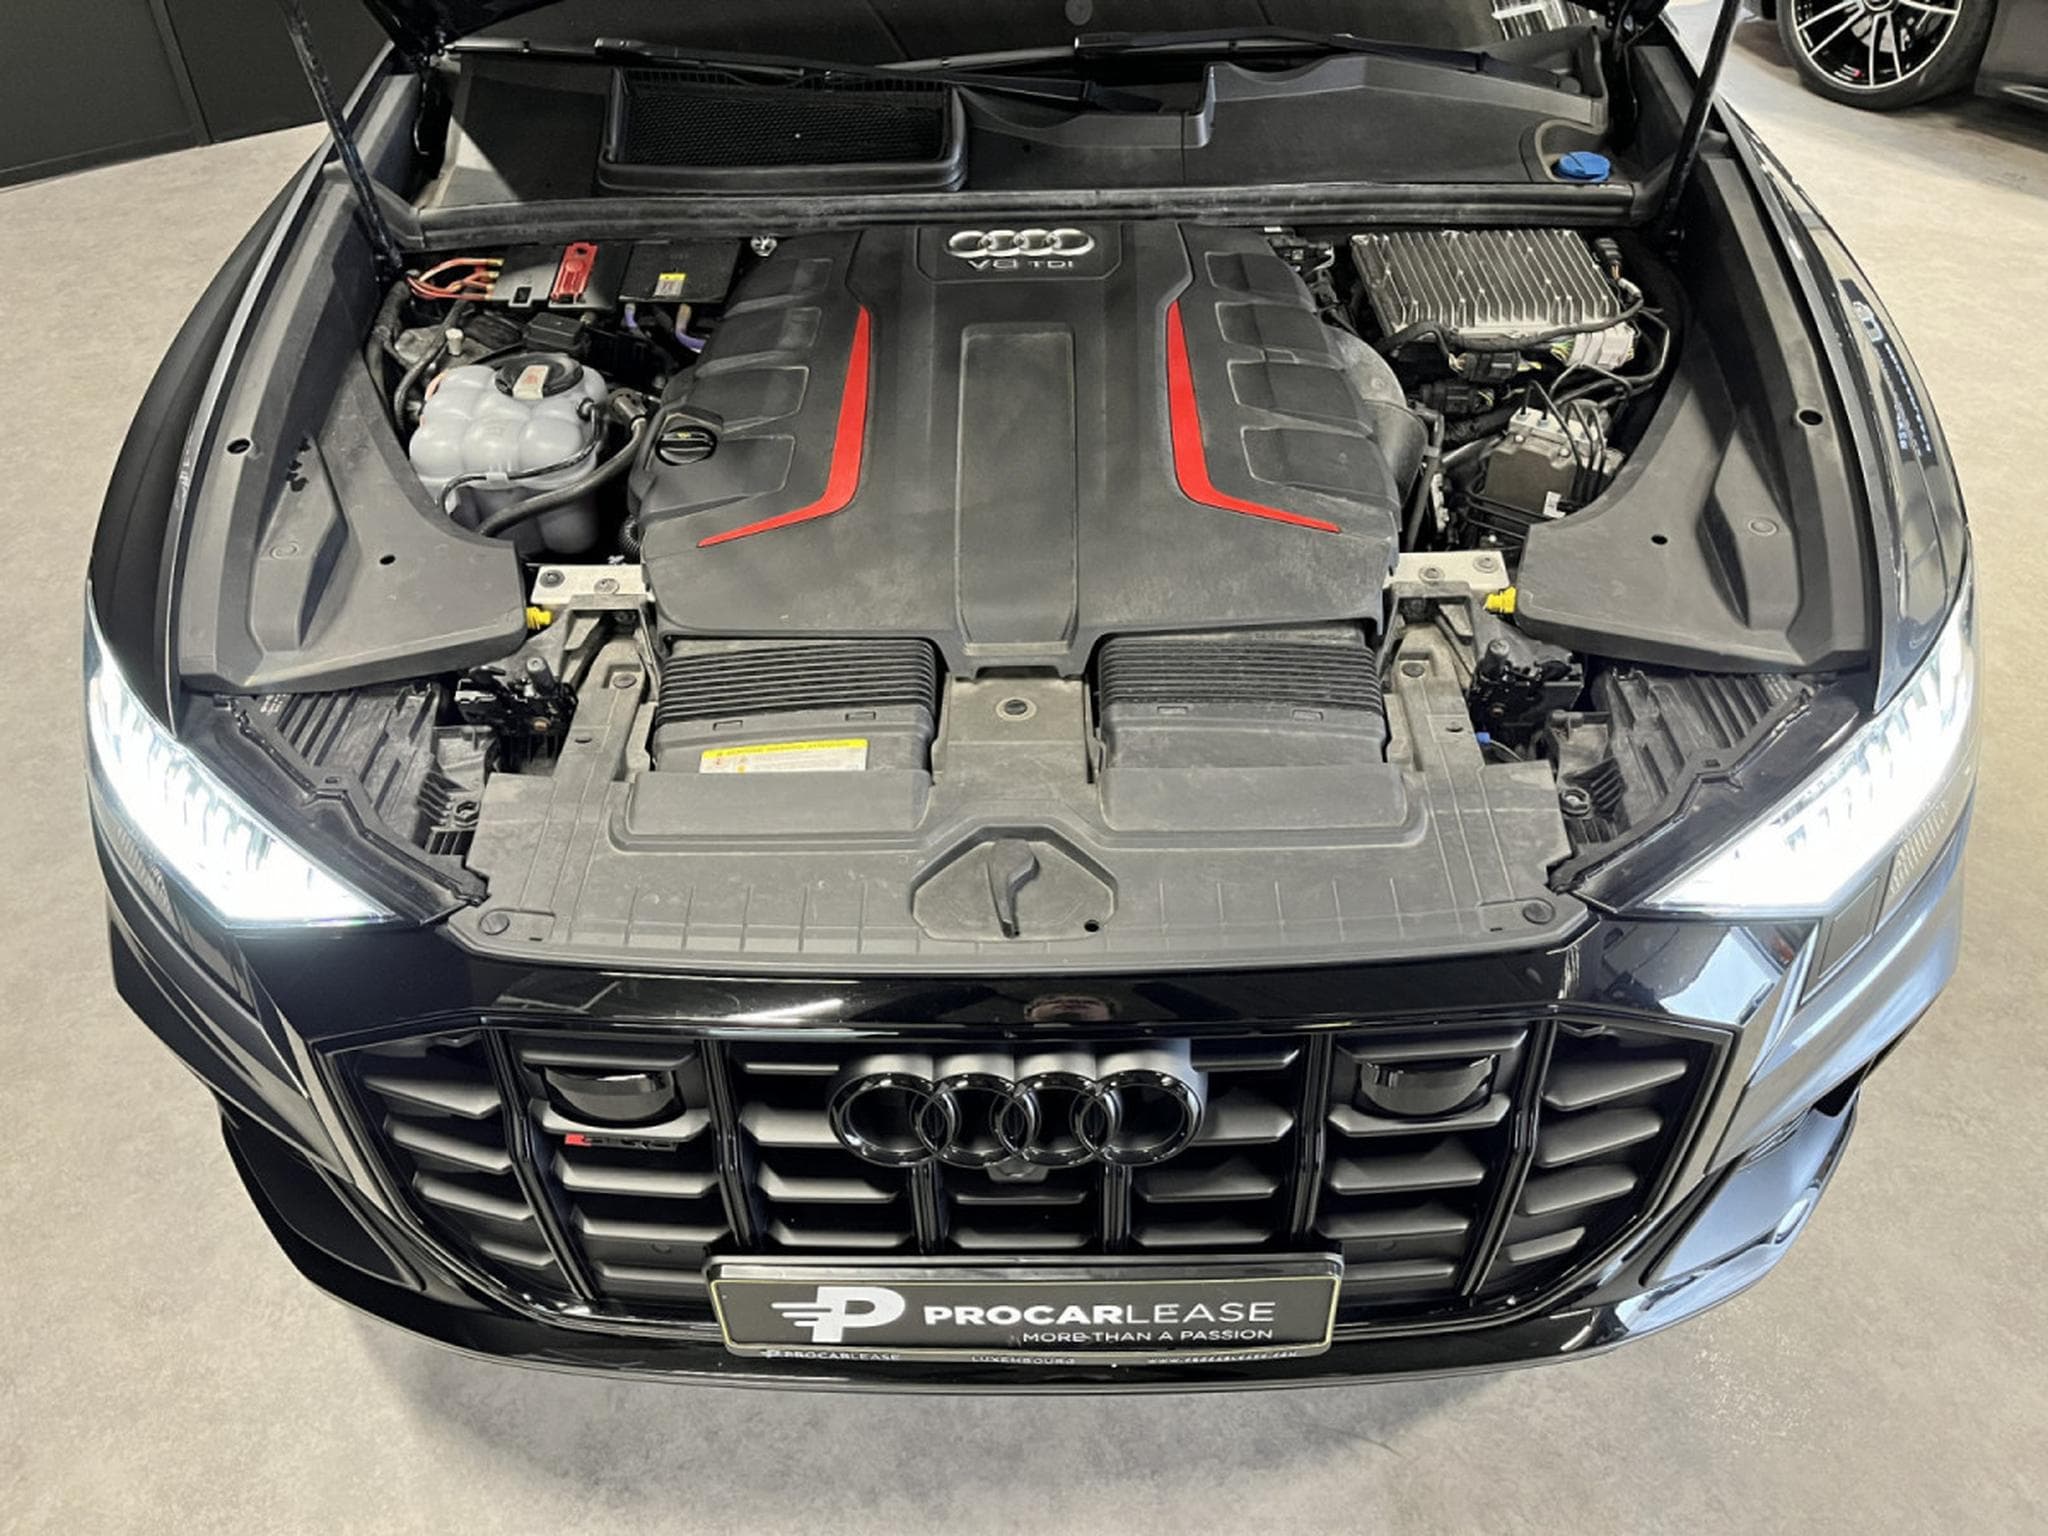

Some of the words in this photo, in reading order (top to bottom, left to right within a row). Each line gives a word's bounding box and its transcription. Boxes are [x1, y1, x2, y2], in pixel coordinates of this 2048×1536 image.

[1028, 259, 1074, 270] TDI
[923, 1301, 1276, 1326] PROCARLEASE
[1023, 1331, 1087, 1343] MORE
[1091, 1330, 1151, 1343] THAN
[1157, 1330, 1174, 1342] A
[1180, 1328, 1274, 1341] PASSION
